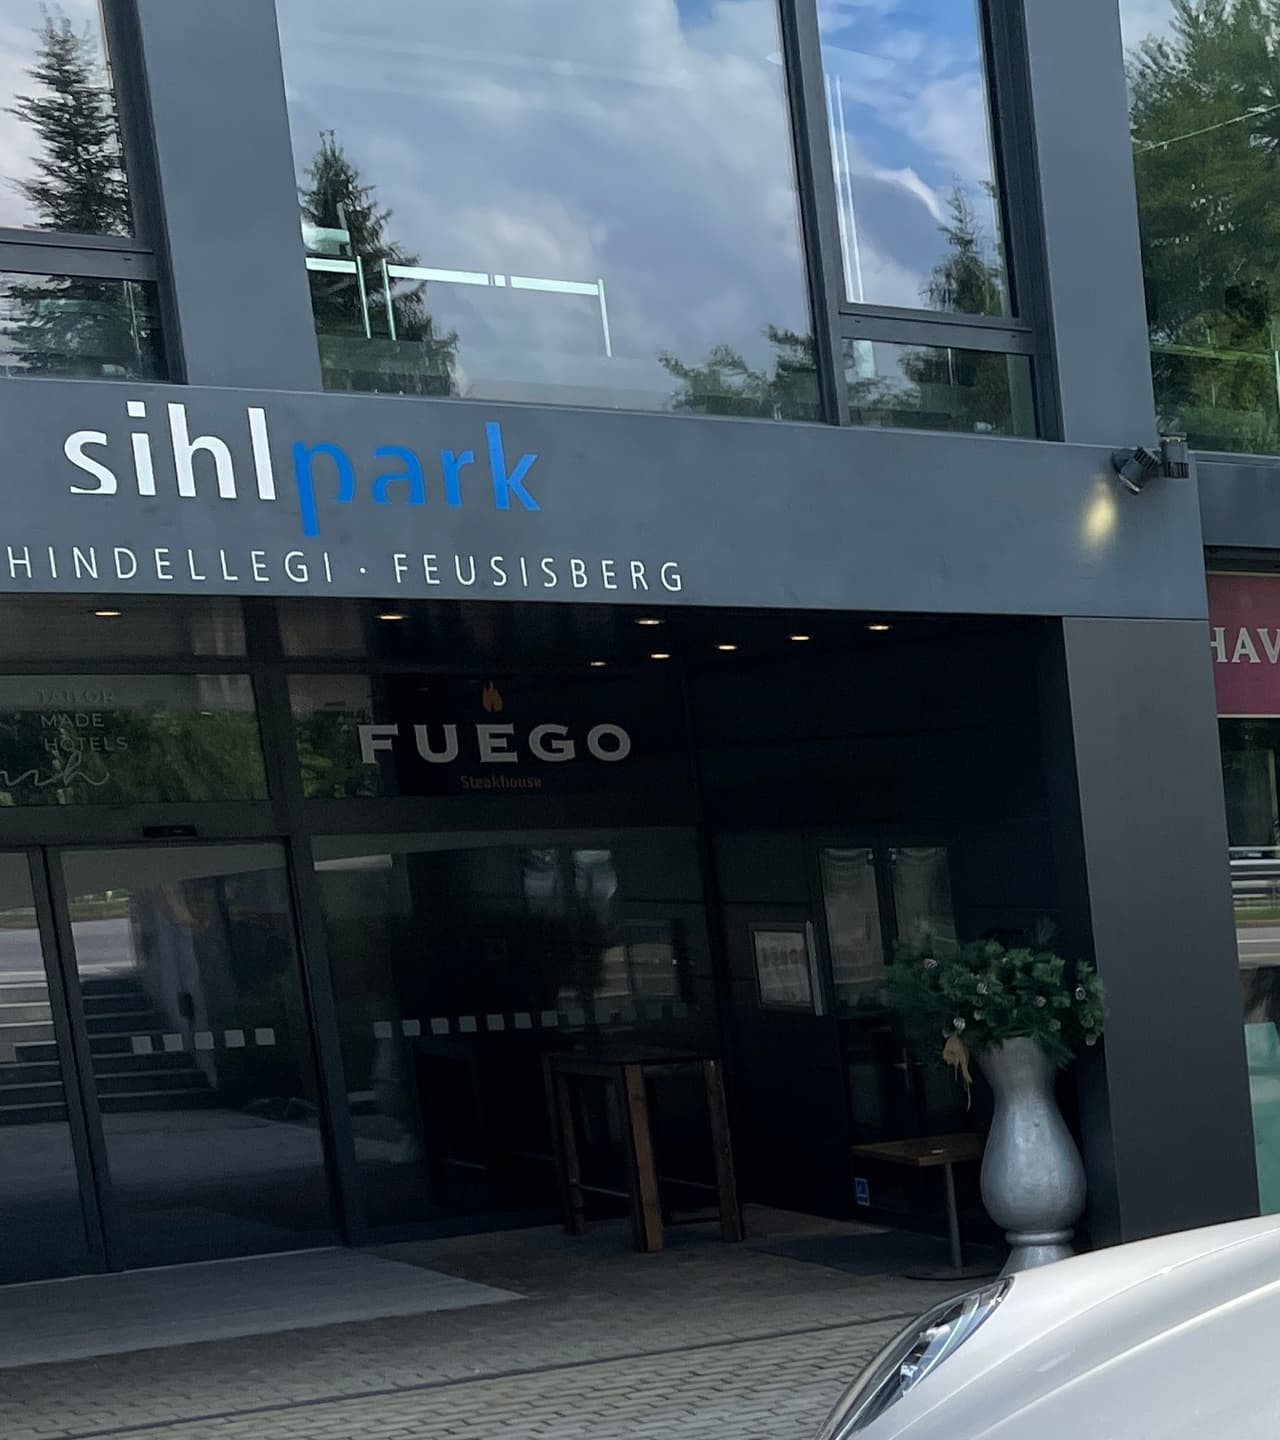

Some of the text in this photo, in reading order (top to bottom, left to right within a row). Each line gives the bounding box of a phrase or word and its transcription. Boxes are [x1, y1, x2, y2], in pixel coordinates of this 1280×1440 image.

[63, 401, 540, 537] sihlpark
[8, 545, 684, 592] HINDELLEGI FEUSISBERG
[40, 712, 105, 728] MADE
[43, 736, 129, 752] HOTELS
[357, 723, 632, 765] FUEGO
[460, 775, 542, 790] Steakhouse
